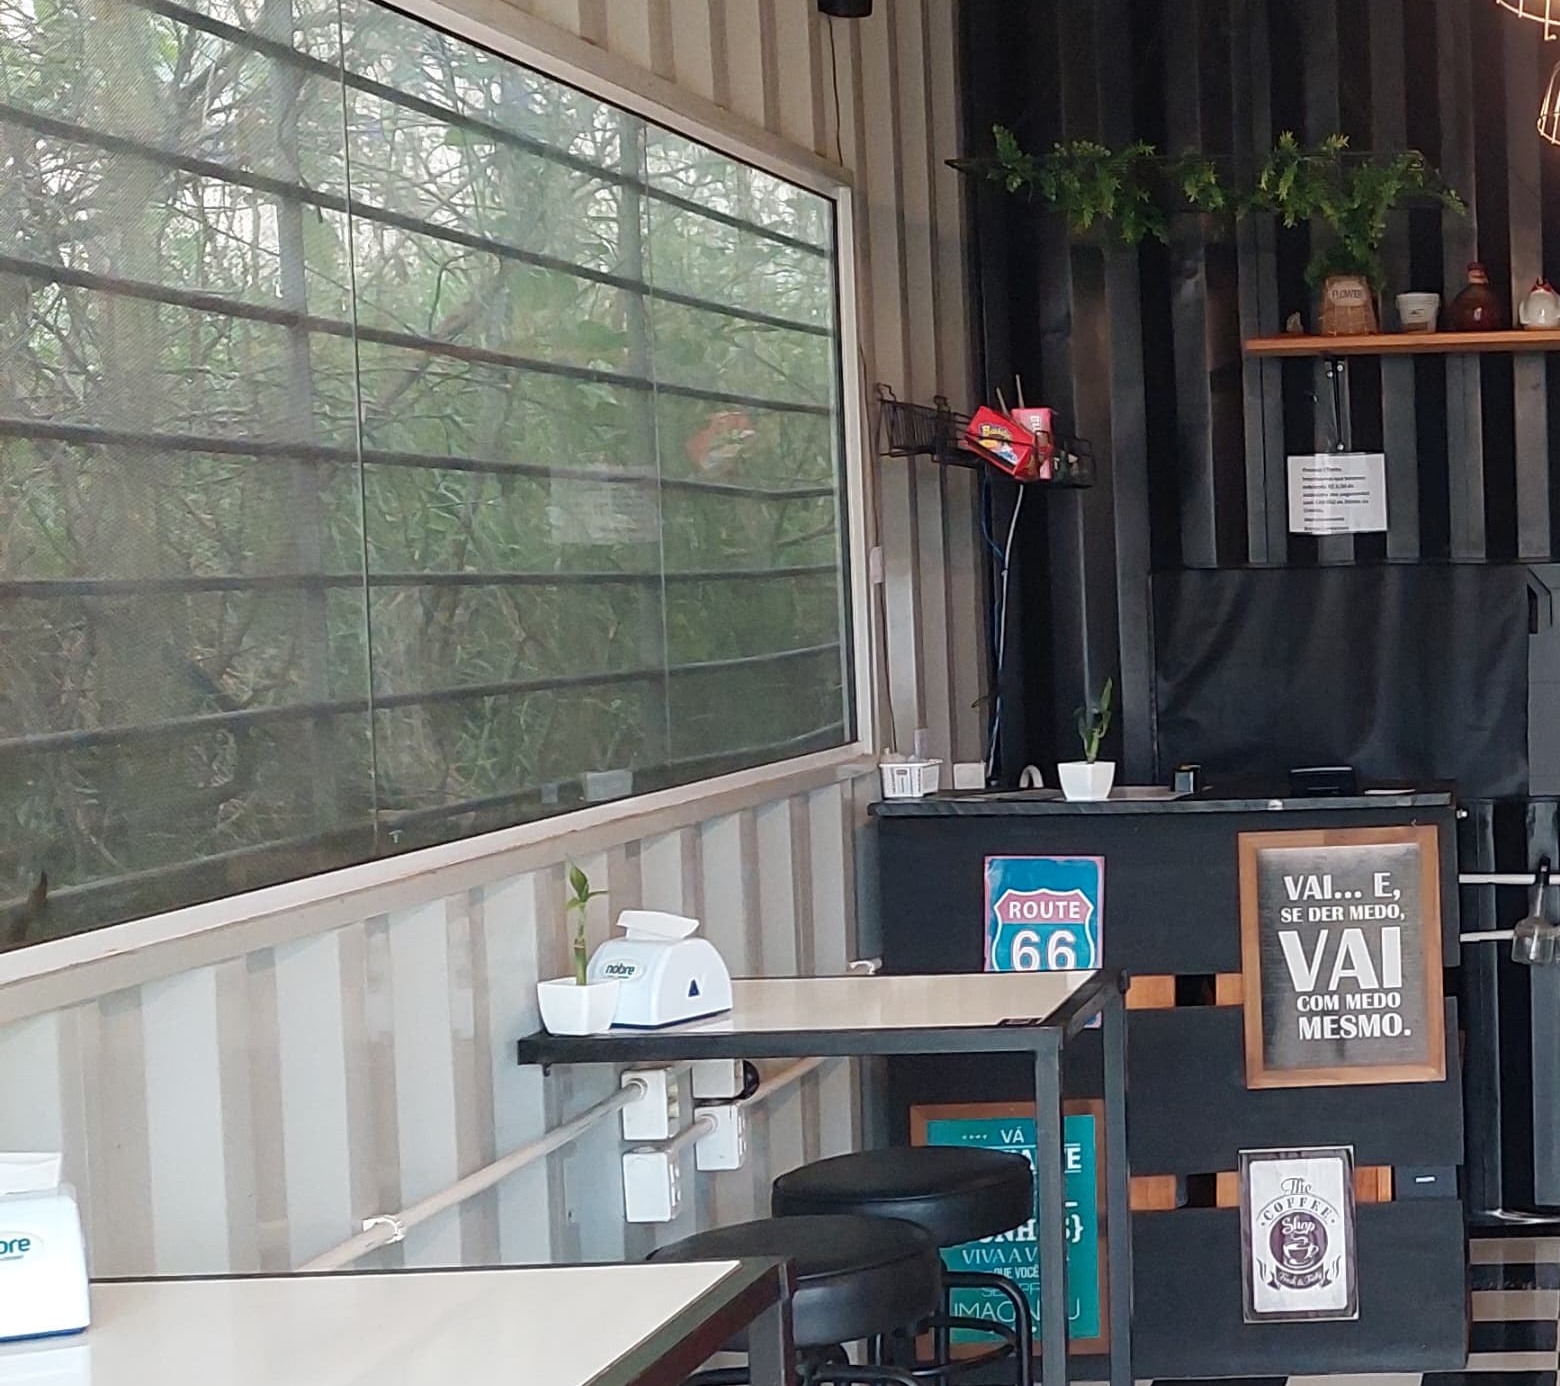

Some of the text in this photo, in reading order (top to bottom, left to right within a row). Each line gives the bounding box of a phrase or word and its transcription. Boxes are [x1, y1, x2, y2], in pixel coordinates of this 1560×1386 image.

[1283, 871, 1402, 901] VAI... E,
[1008, 900, 1081, 919] ROUTE
[1280, 904, 1406, 923] SE DER MEDO,
[1012, 929, 1077, 971] 66
[1277, 926, 1403, 993] VAI
[604, 963, 636, 975] nobre
[1296, 991, 1402, 1012] COM MEDO
[1298, 1012, 1412, 1041] MESMO.
[1281, 1177, 1313, 1195] The
[1263, 1197, 1333, 1222] COFFEE
[1281, 1215, 1316, 1235] Shop
[962, 1248, 1005, 1265] VIVA
